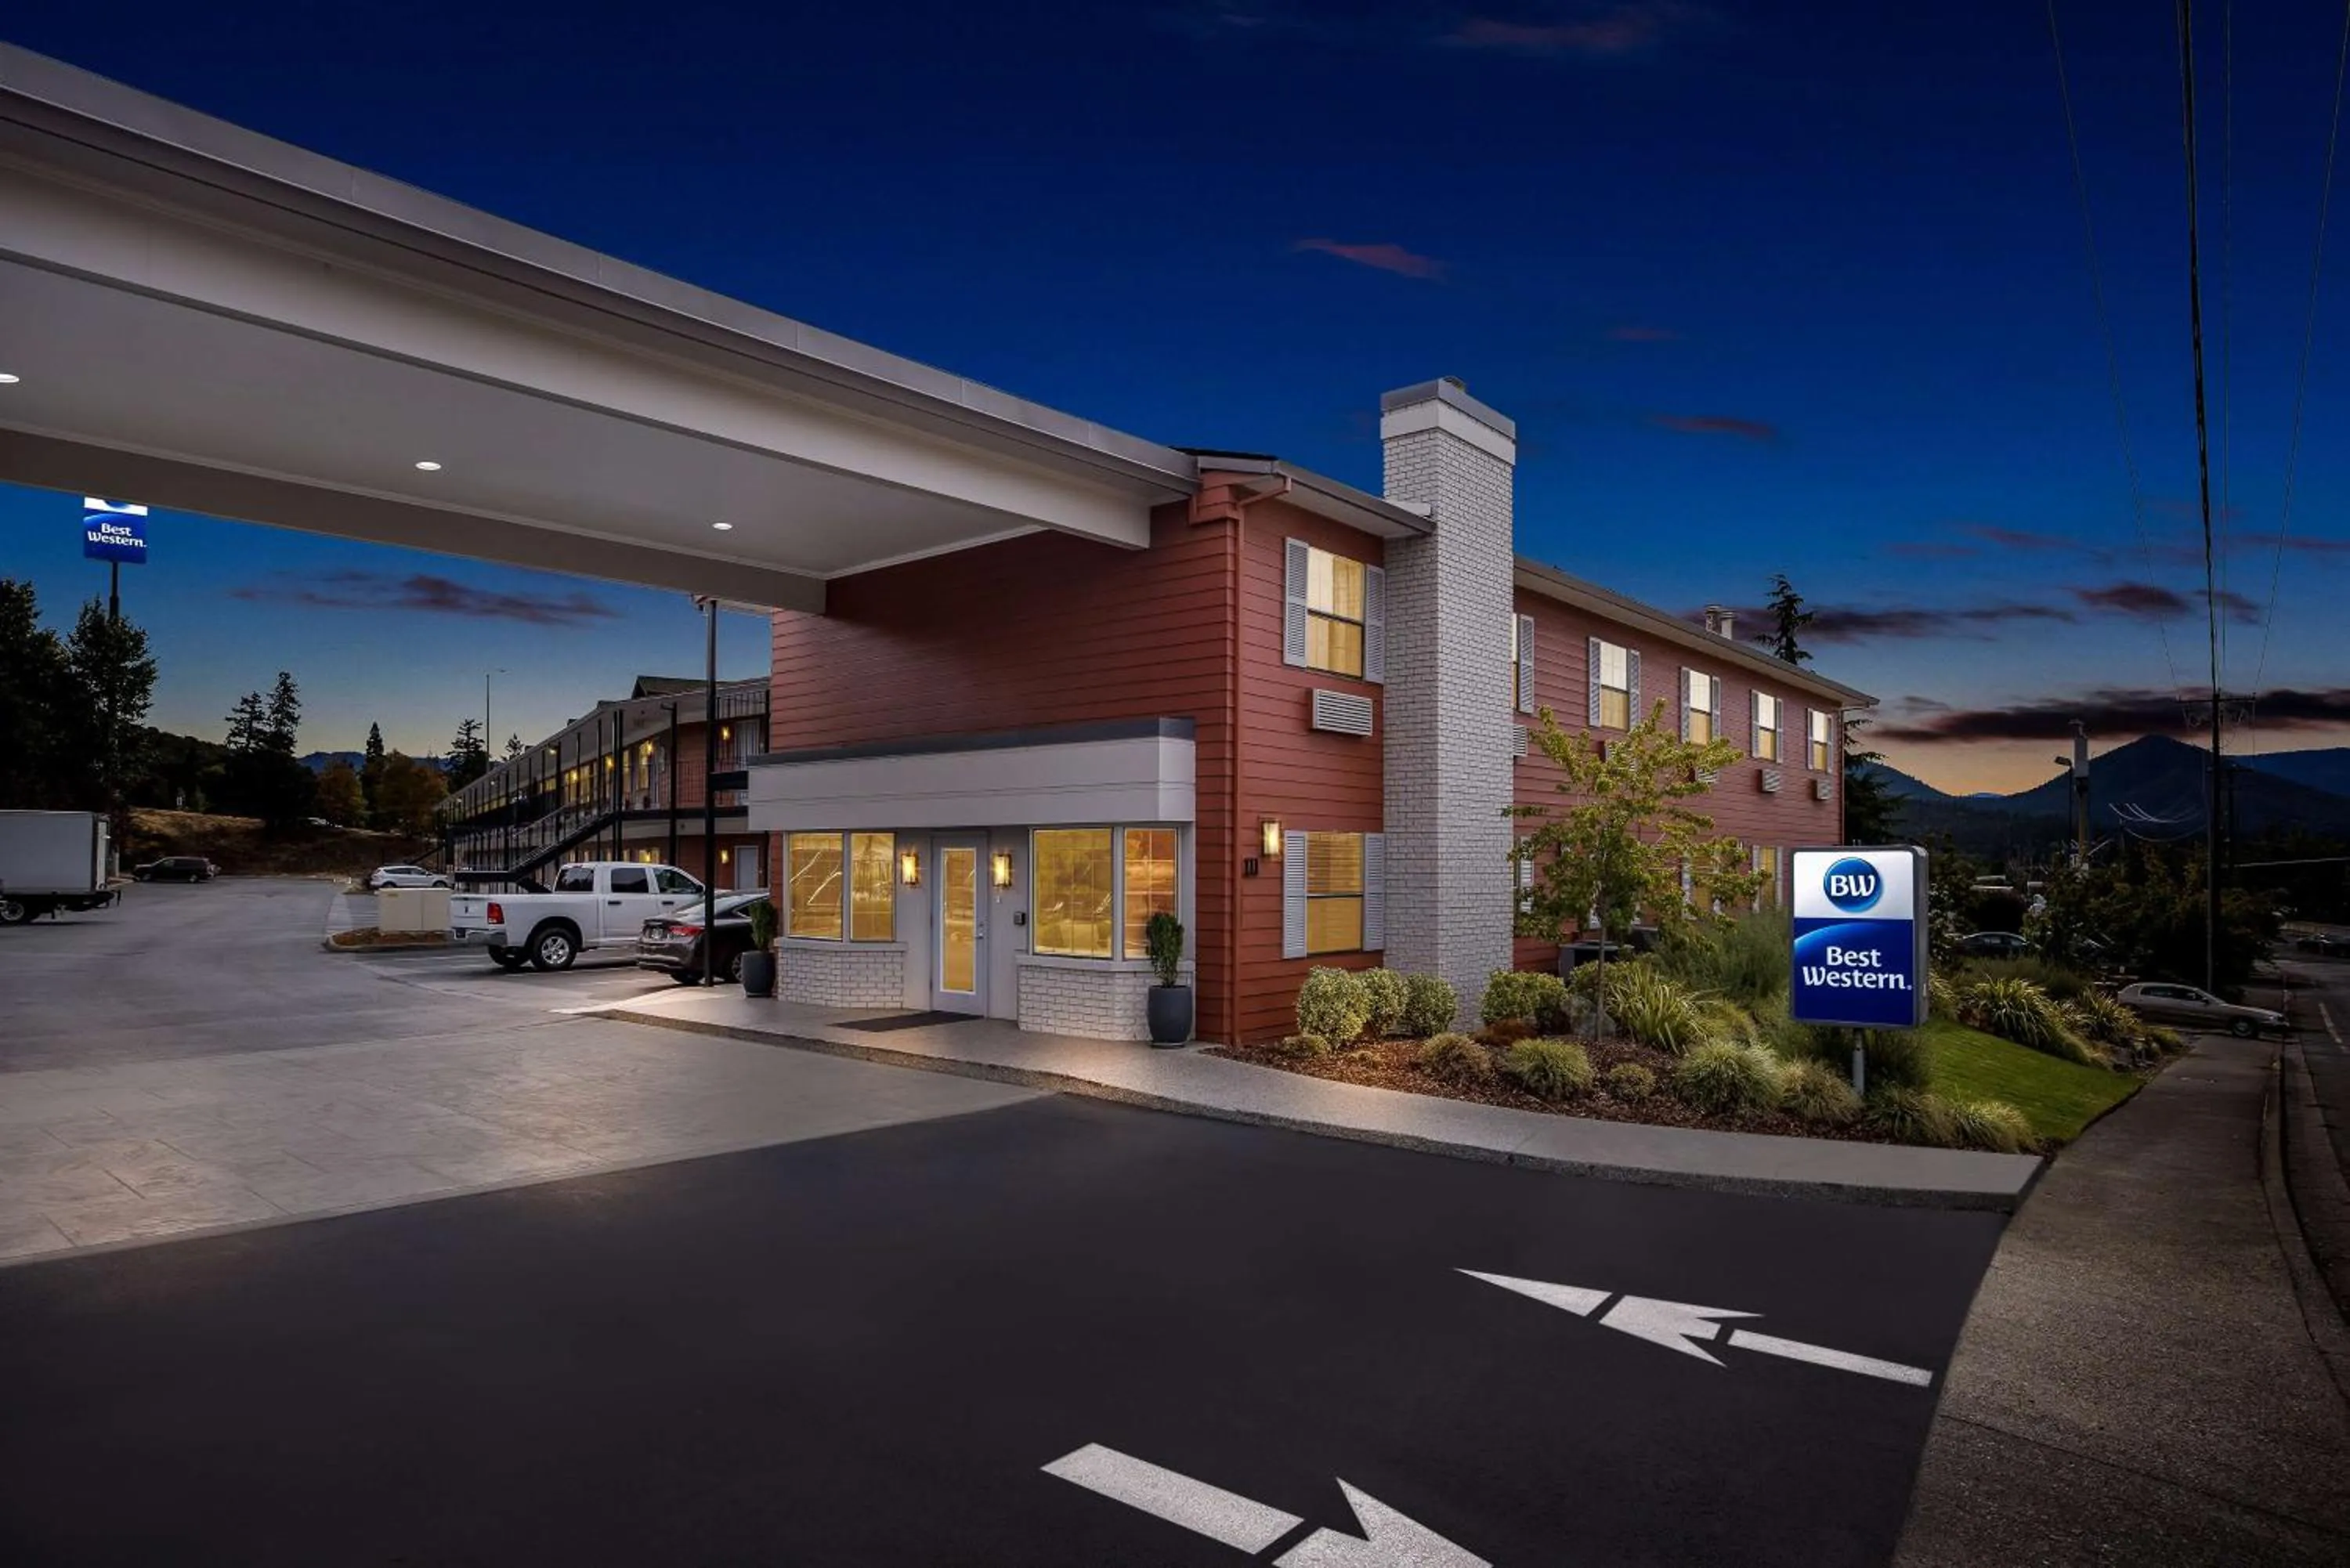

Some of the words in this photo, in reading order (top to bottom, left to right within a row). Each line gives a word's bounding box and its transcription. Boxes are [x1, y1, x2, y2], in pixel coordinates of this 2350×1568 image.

[101, 522, 132, 537] Best
[1830, 874, 1876, 897] BW
[1826, 945, 1882, 968] Best
